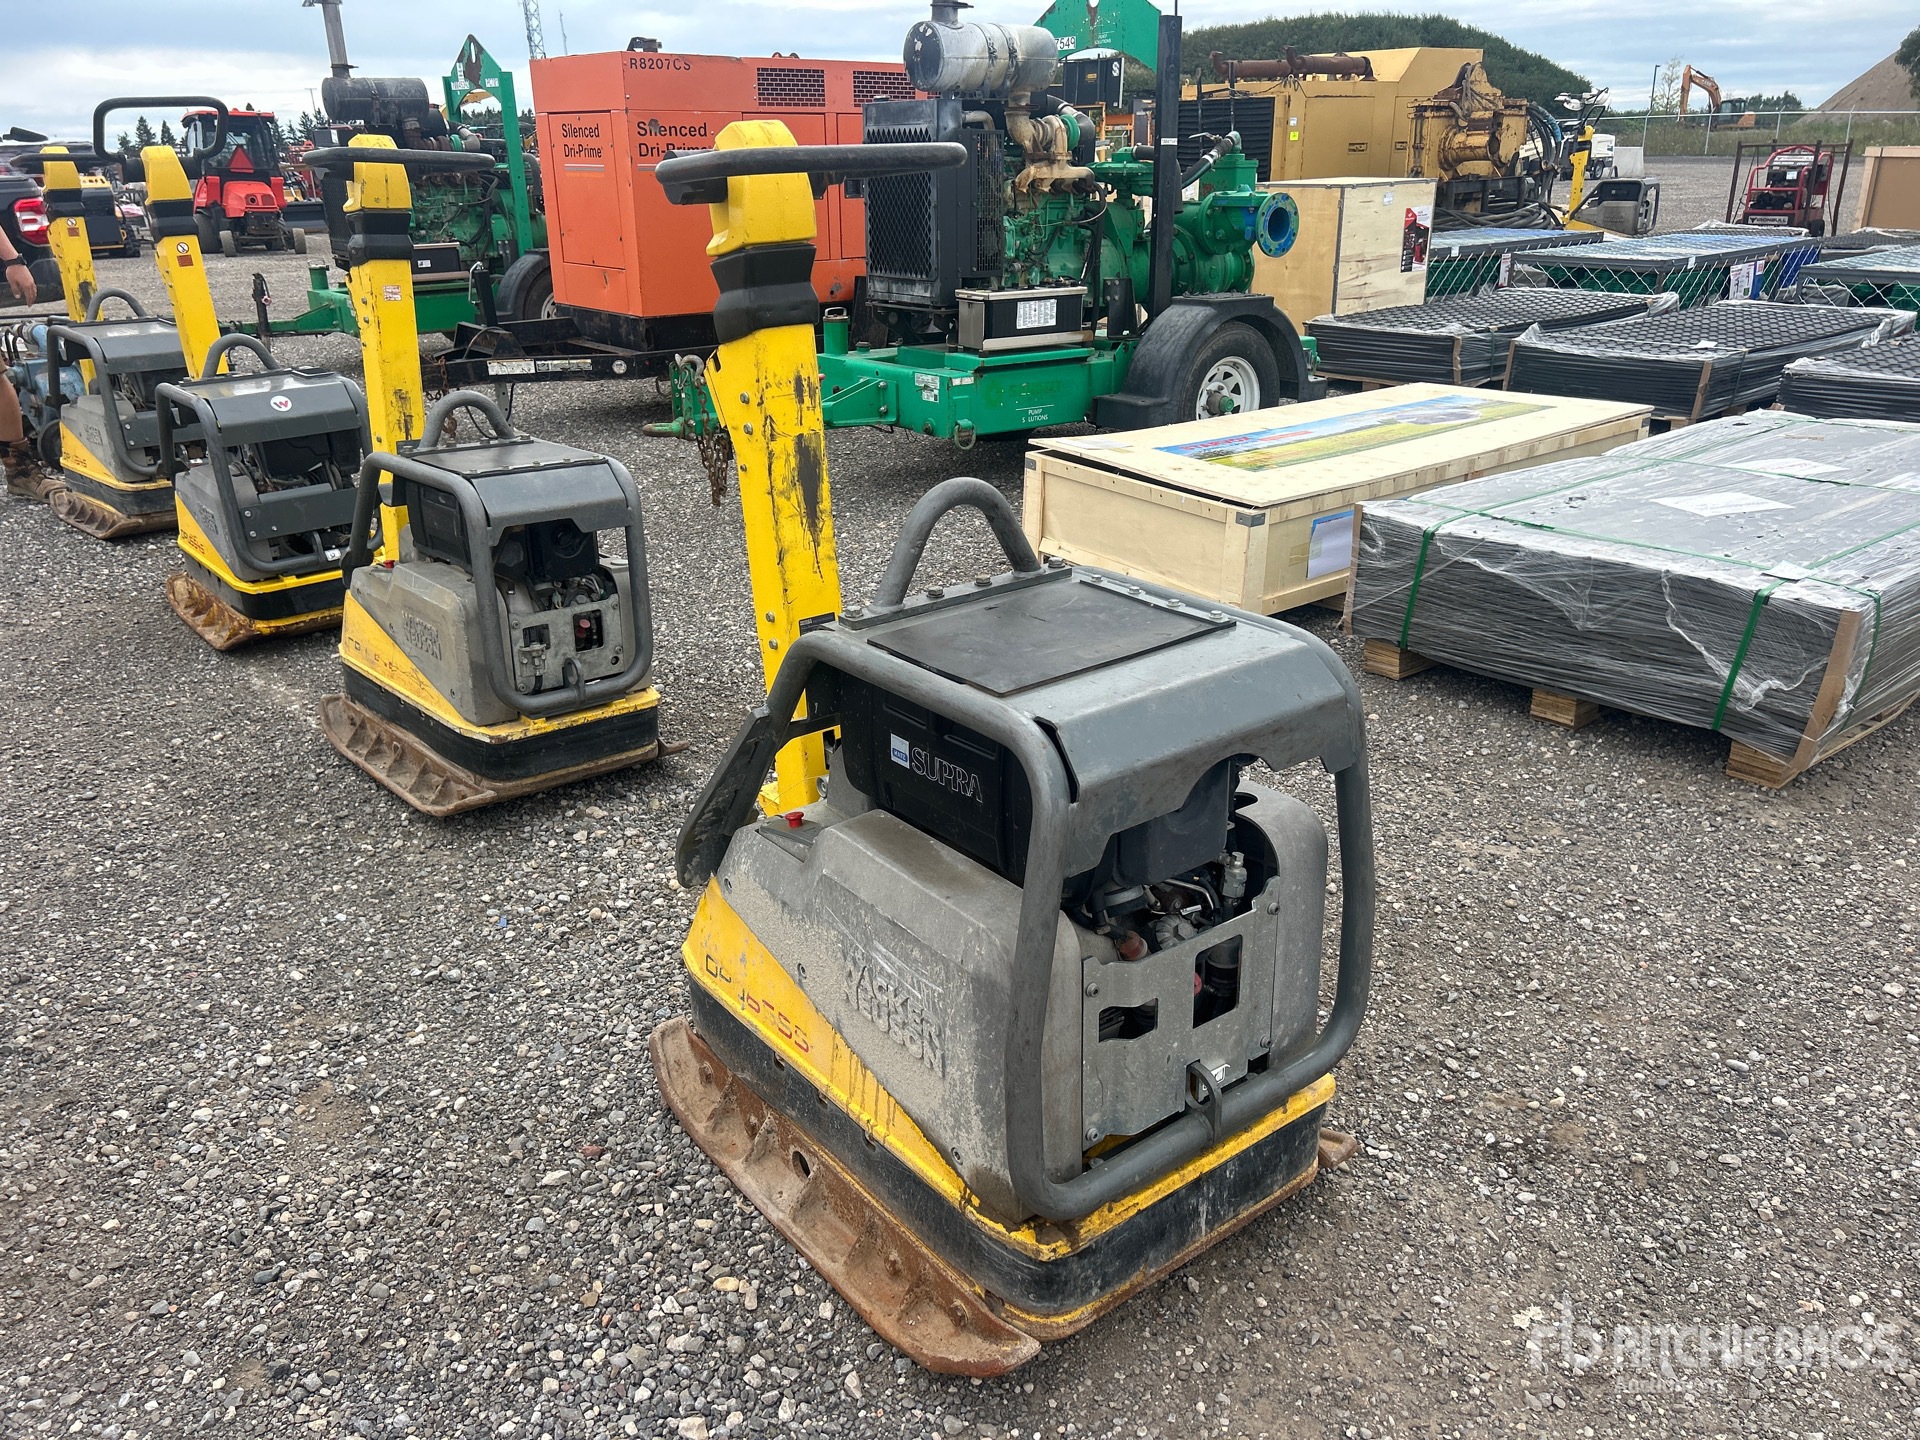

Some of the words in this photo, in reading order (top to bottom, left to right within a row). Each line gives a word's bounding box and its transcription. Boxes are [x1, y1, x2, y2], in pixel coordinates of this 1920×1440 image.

[629, 57, 691, 70] R8207CS
[561, 122, 600, 138] Silenced
[563, 143, 602, 158] Dri-Prime
[1021, 414, 1049, 423] SLUTIONS
[912, 747, 983, 803] SUPRA
